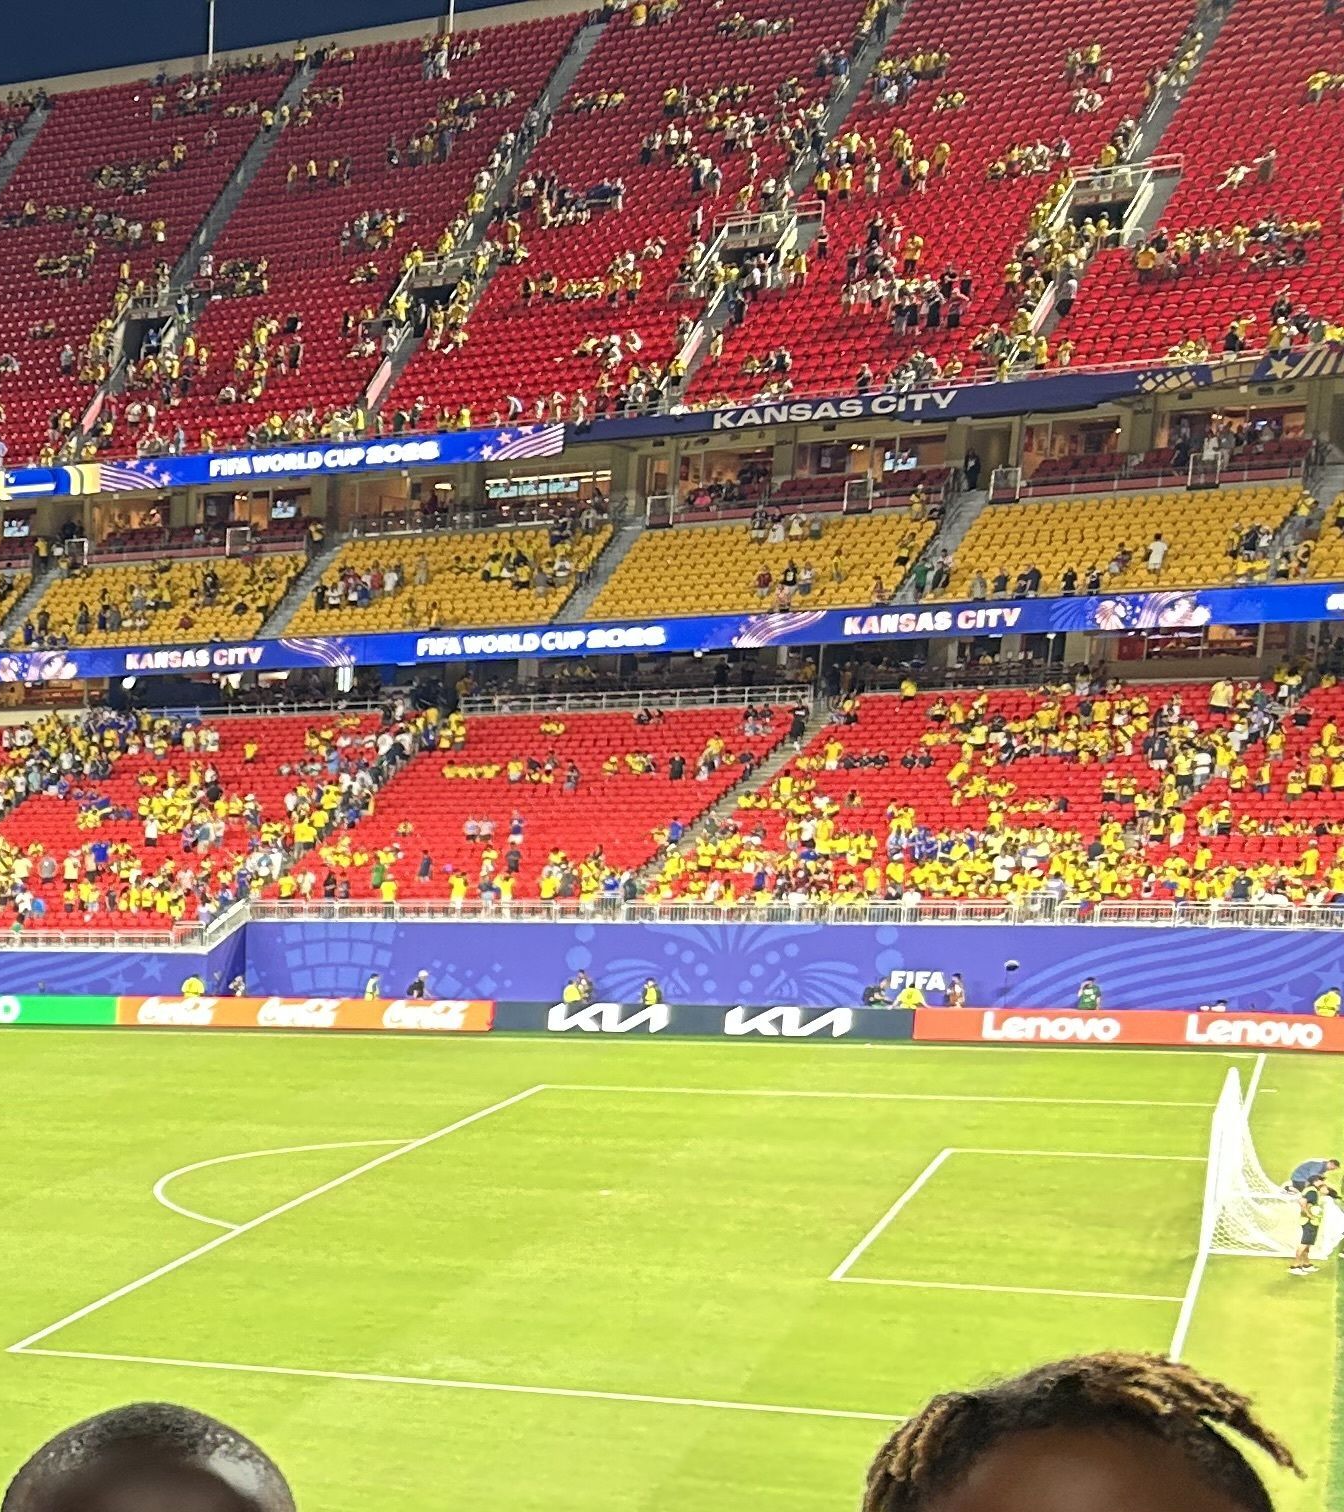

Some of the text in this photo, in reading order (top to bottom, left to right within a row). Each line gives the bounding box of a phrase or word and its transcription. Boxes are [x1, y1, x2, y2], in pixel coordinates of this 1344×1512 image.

[712, 389, 958, 429] KANSAS CITY
[209, 454, 253, 478] FIFA
[252, 449, 324, 473] WORLD
[323, 445, 367, 468] CUP
[843, 607, 1022, 635] KANSAS CITY
[125, 646, 265, 670] KANSAS CITY
[416, 637, 462, 658] FIFA
[462, 631, 542, 656] WORLD
[541, 630, 587, 652] CUP
[889, 970, 946, 991] FIFA
[981, 1009, 1121, 1041] Lenovo
[1185, 1012, 1324, 1048] Lenovo
